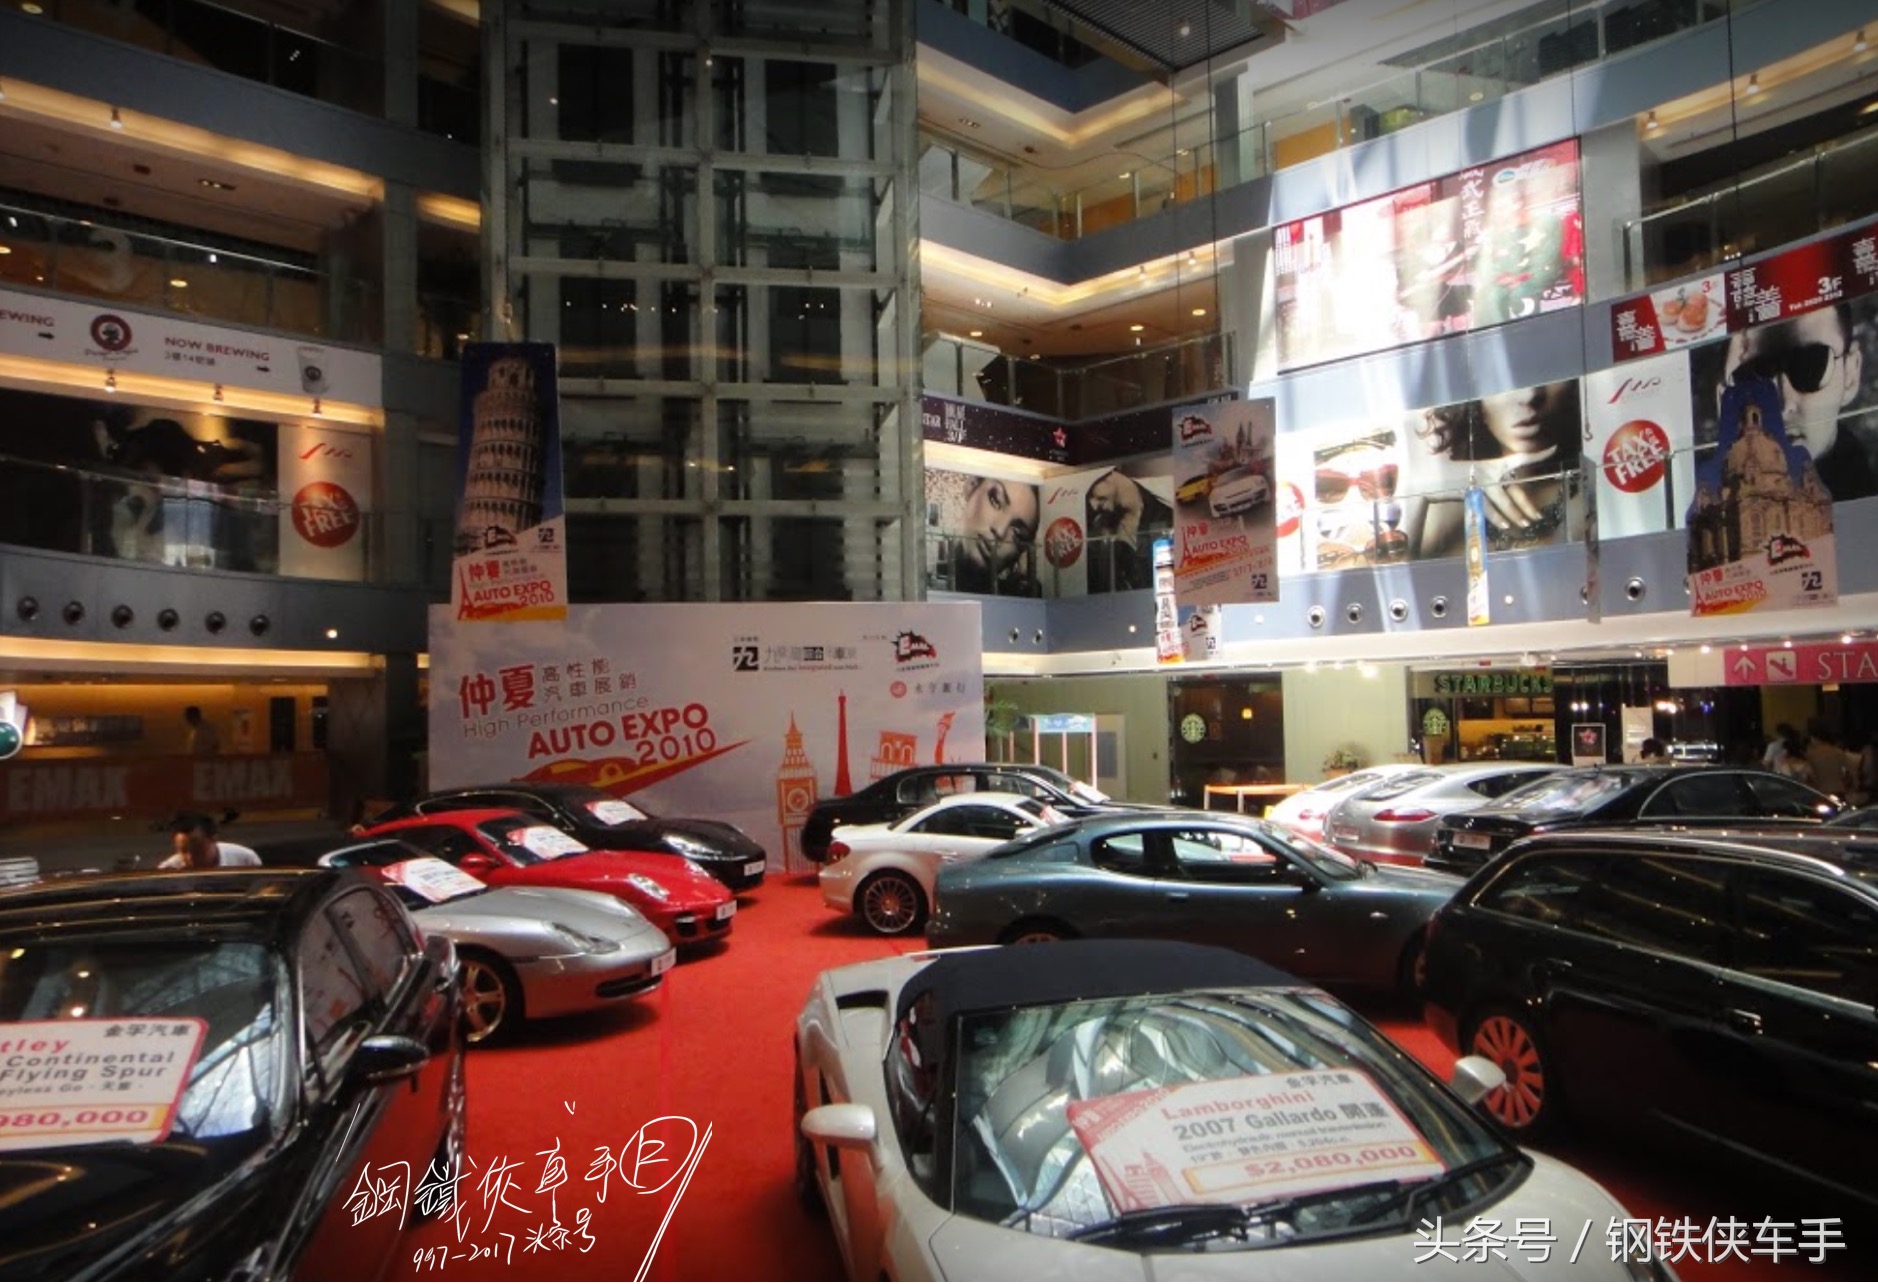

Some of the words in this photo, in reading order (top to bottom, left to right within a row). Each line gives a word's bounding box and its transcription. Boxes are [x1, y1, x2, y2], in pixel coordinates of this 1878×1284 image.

[1818, 276, 1842, 294] 3F
[164, 336, 202, 350] NOW
[205, 342, 270, 361] BREWING
[1192, 541, 1218, 554] AUTO
[1220, 535, 1246, 549] EXPO
[474, 586, 510, 602] AUTO
[513, 580, 551, 596] EXPO
[519, 590, 554, 606] 2010
[1704, 587, 1733, 601] AUTO
[1735, 580, 1764, 595] EXPO
[542, 657, 611, 684] 高性能
[1818, 651, 1878, 680] STA
[459, 664, 535, 719] 仲夏
[543, 672, 637, 704] 汽車展銷
[1435, 674, 1553, 694] STARBUCKS
[464, 713, 510, 739] High
[517, 696, 649, 729] Performance
[528, 720, 615, 760] AUTO
[621, 703, 709, 741] EXPO
[635, 728, 717, 766] 2010
[7, 765, 129, 812] EMAX
[193, 760, 294, 801] EMAX
[7, 1051, 175, 1068] Continental
[0, 1067, 88, 1084] Flying
[100, 1065, 167, 1080] Spur
[1161, 1090, 1315, 1121] Lamborghini
[1172, 1117, 1237, 1141] 2007
[1244, 1106, 1338, 1130] Gallardo
[1244, 1145, 1418, 1178] $2,080,000
